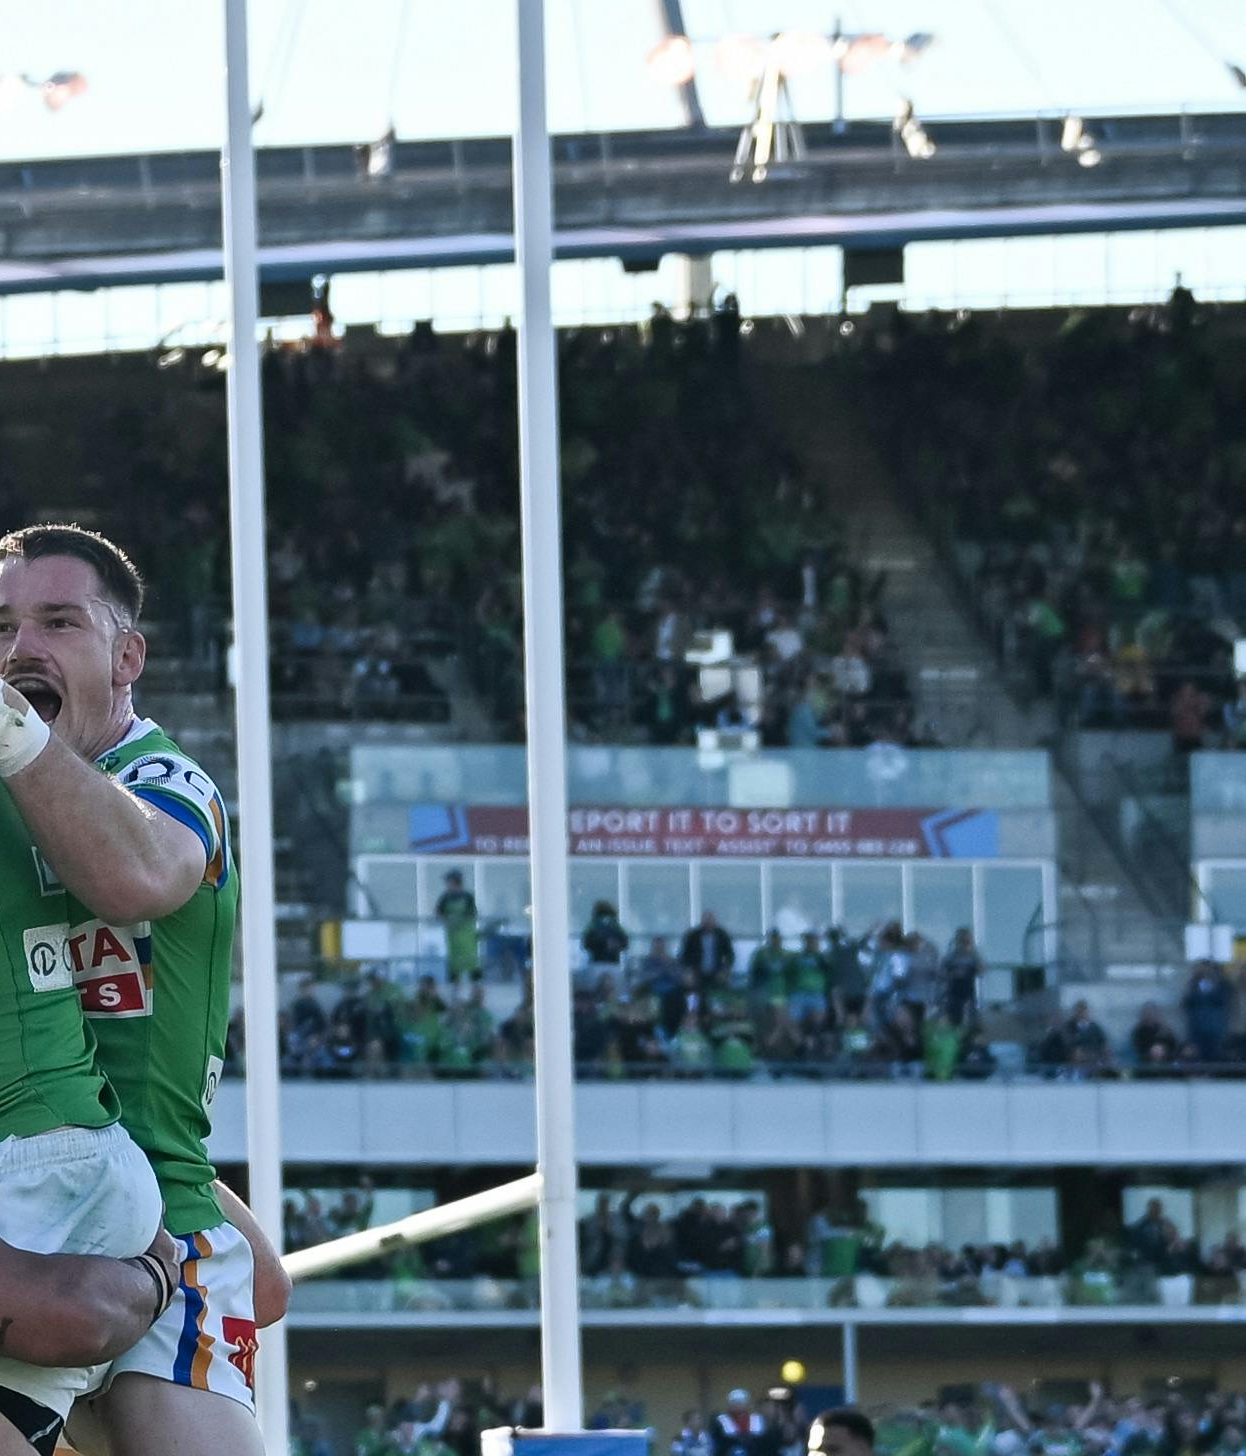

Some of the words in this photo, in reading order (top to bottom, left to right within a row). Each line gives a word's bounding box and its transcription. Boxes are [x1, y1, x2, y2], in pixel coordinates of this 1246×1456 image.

[569, 809, 659, 833] EPORT
[668, 810, 691, 832] IT
[700, 810, 739, 834] TO
[746, 810, 818, 834] SORT
[826, 810, 851, 833] IT
[577, 838, 601, 852] AN
